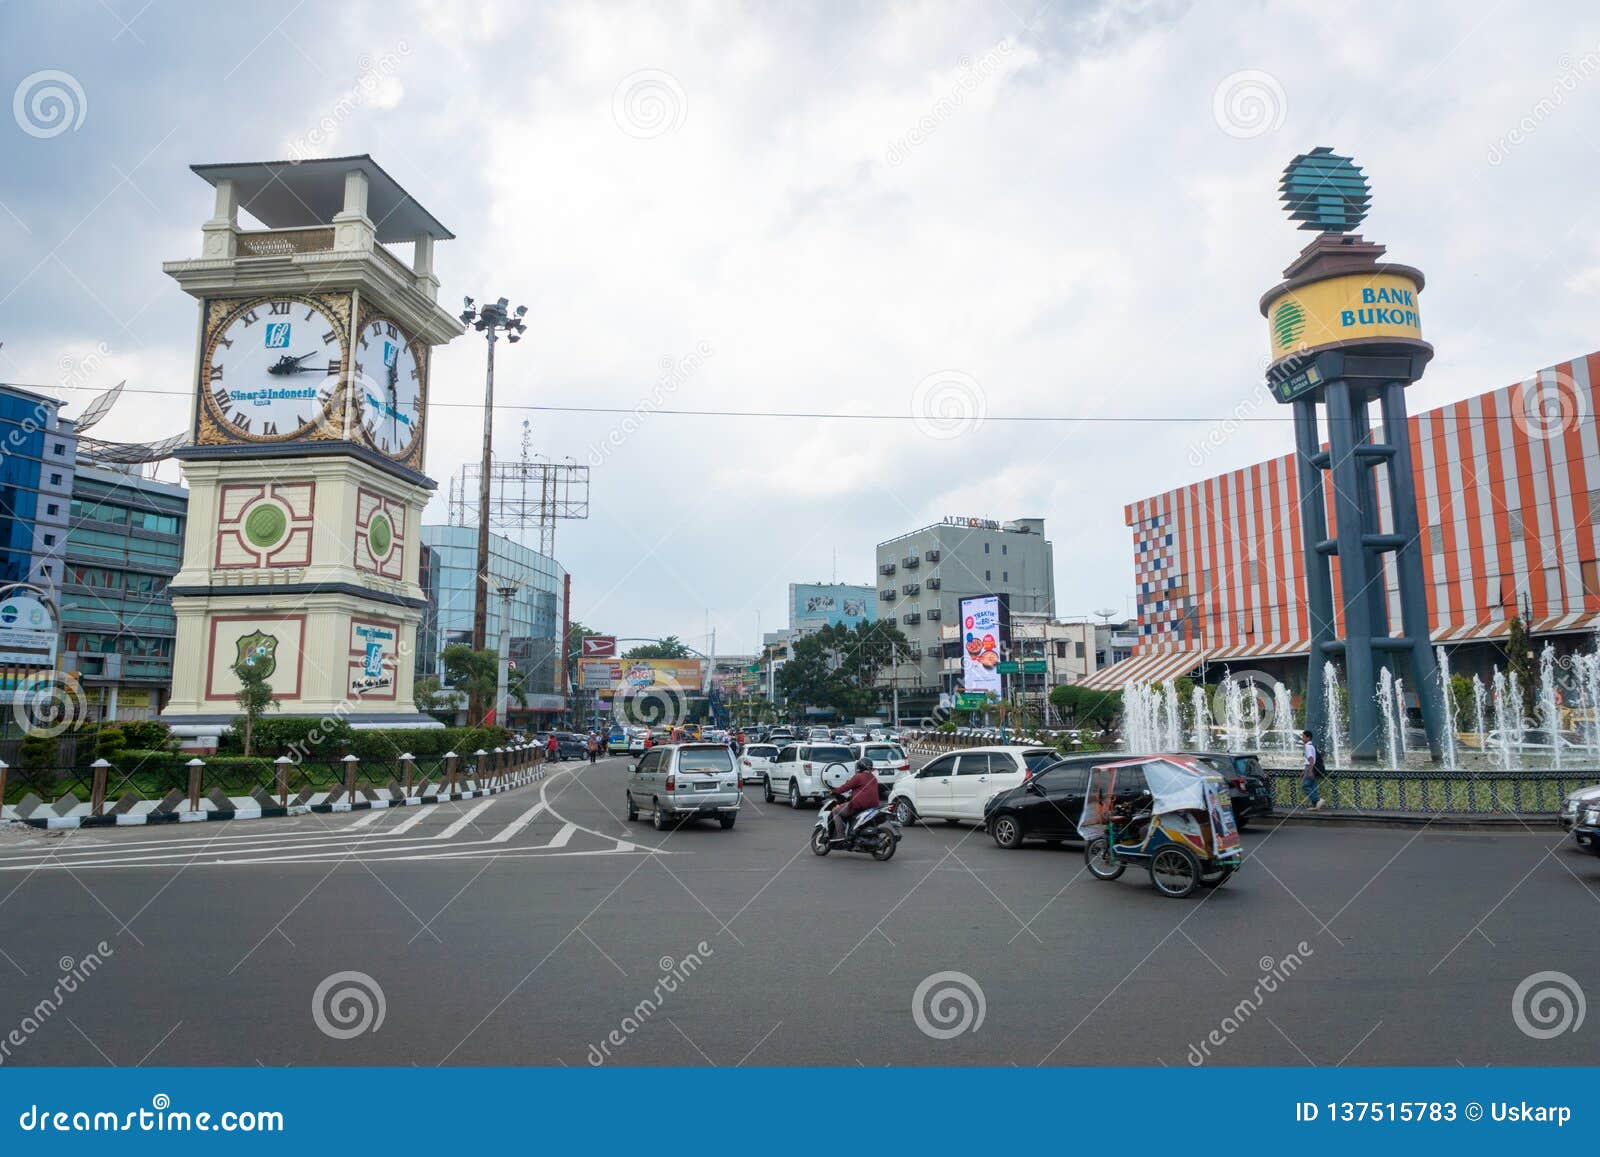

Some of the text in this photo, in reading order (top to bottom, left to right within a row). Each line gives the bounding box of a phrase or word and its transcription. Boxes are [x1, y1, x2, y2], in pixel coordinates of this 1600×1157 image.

[1362, 287, 1413, 307] BANK
[268, 302, 291, 315] XII
[240, 309, 259, 328] XI
[221, 336, 234, 350] X
[322, 330, 338, 345] II
[232, 411, 252, 433] VII
[263, 421, 279, 435] VI
